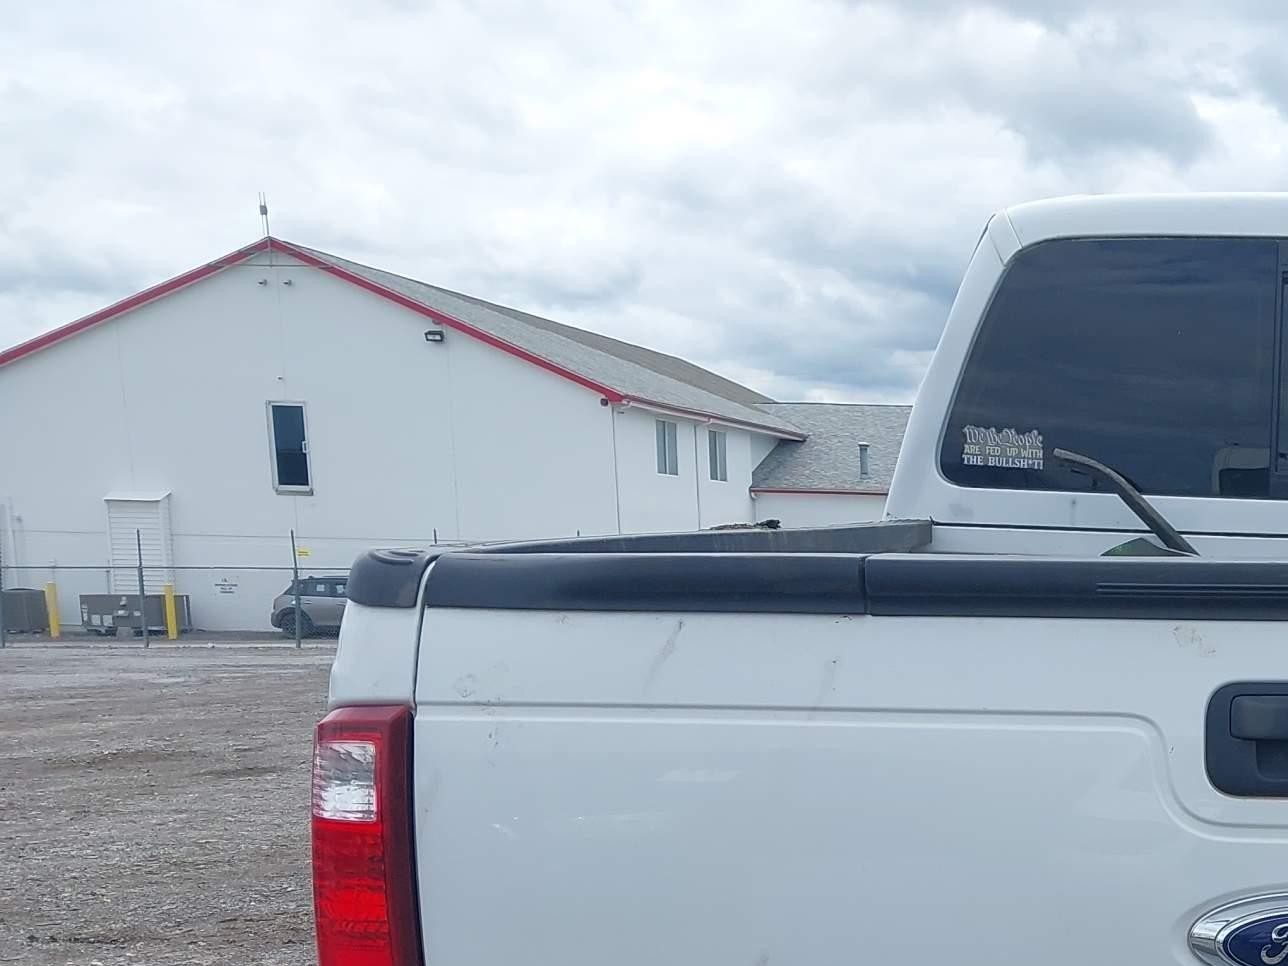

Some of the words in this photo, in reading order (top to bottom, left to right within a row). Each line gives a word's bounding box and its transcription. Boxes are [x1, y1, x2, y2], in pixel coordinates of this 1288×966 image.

[1001, 427, 1043, 447] People
[963, 444, 981, 455] ARE
[985, 446, 1001, 456] FED
[1006, 447, 1018, 457] UP
[1020, 448, 1043, 458] WITH
[962, 454, 984, 466] THE
